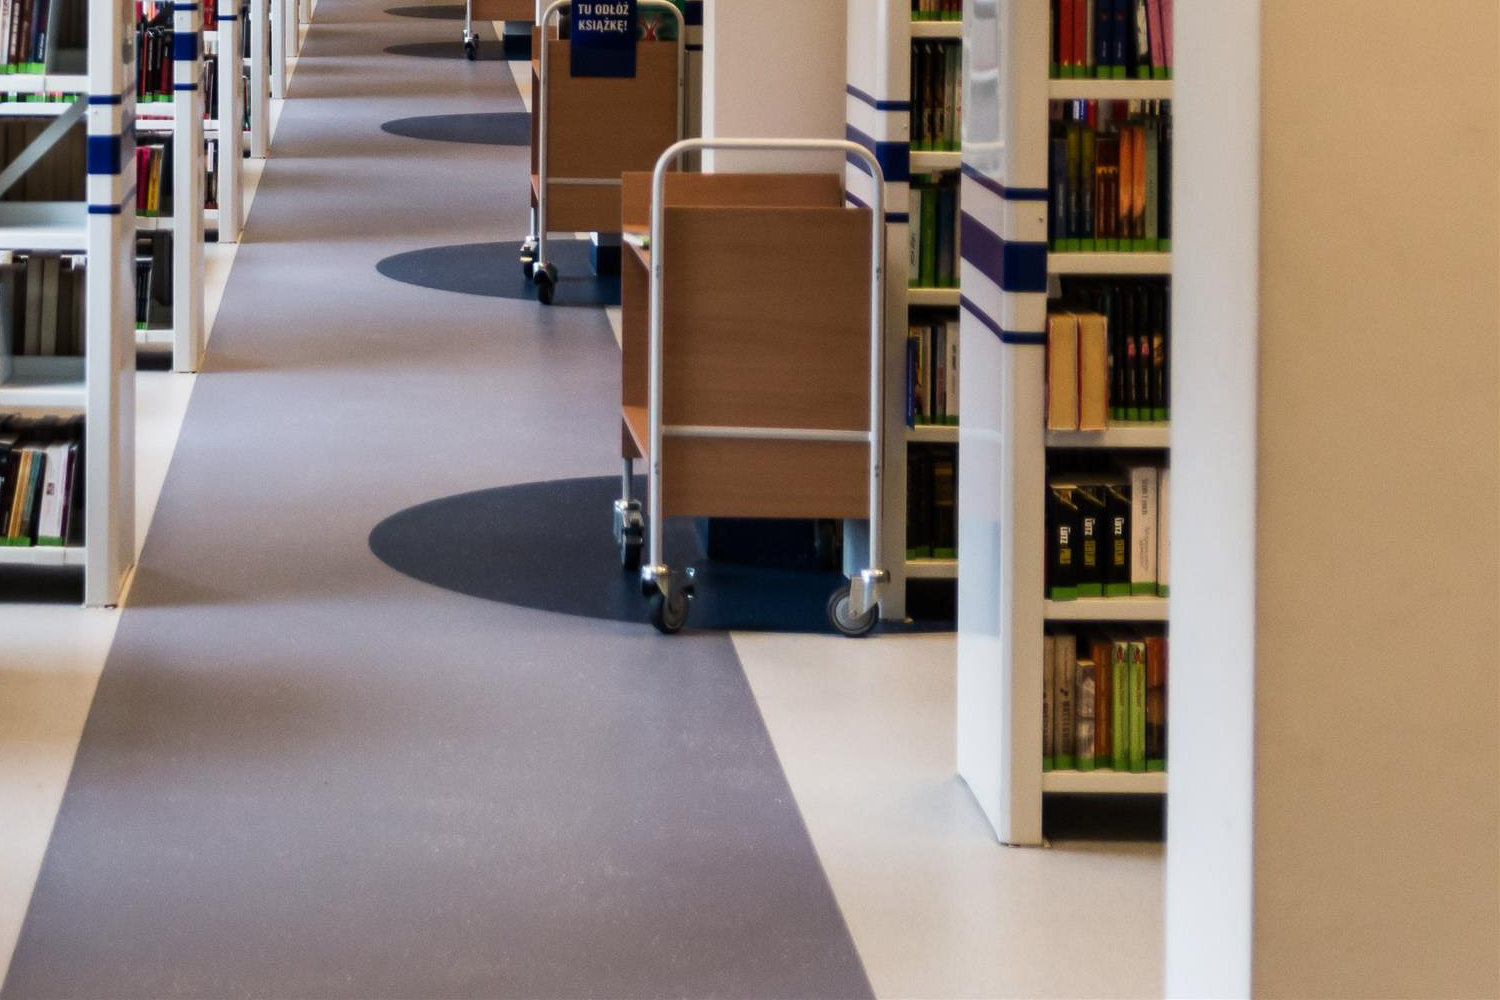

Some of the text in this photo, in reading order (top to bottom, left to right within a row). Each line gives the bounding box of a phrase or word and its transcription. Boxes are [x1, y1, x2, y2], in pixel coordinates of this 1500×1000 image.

[578, 1, 629, 15] TU ODŁÓŻ
[578, 17, 628, 33] KSIĄŻKĘ!
